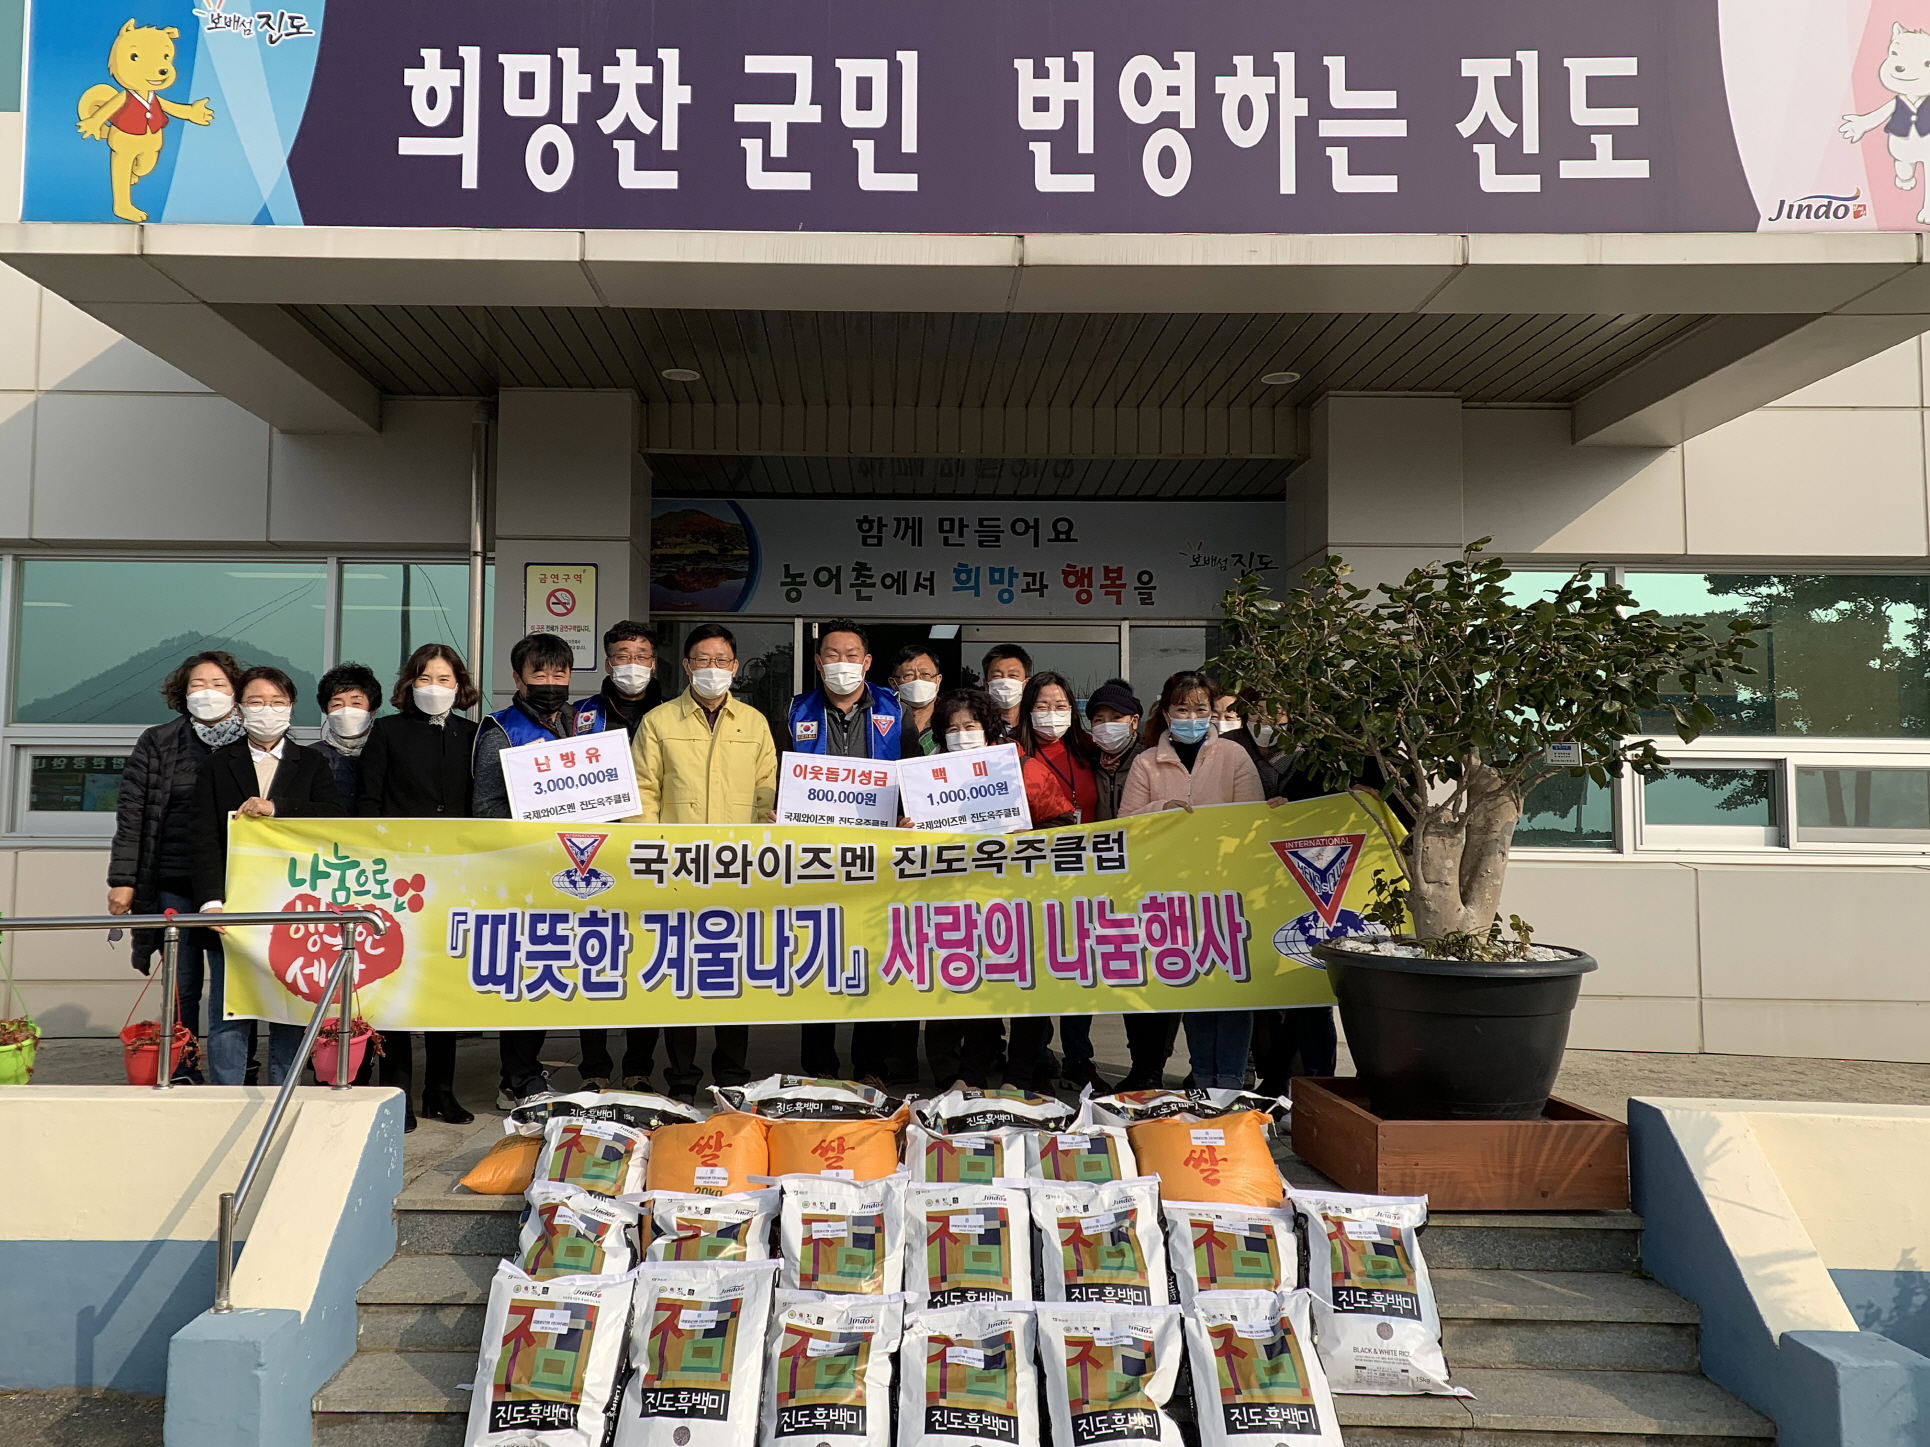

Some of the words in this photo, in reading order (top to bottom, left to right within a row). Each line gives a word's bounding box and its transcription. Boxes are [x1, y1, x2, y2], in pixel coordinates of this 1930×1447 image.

[206, 12, 253, 36] 보배섬
[256, 10, 314, 45] 진도
[398, 45, 692, 193] 희망찬
[734, 50, 919, 192] 군민
[1014, 51, 1408, 197] 번영하는
[1455, 50, 1650, 193] 진도
[1768, 199, 1851, 222] Jindo
[855, 514, 924, 548] 함께
[937, 516, 1079, 549] 만들어요
[1230, 551, 1280, 578] 진도
[538, 573, 583, 585] 금연구역
[779, 560, 936, 604] 농어촌에서
[952, 562, 1049, 605] 희망과
[1061, 562, 1158, 606] 행복을
[533, 767, 620, 796] 3,000,000원
[792, 763, 888, 788] 이웃돕기성금
[522, 802, 577, 821] 국제와이즈멘
[579, 792, 631, 812] 진도옥주클럽
[807, 788, 877, 807] 800,000원
[926, 780, 1010, 807] 1,000,000원
[784, 811, 835, 825] 국제와이즈멘
[916, 815, 968, 832] 국제와이즈멘
[970, 806, 1021, 825] 진도옥주클럽
[1285, 837, 1352, 849] INTERNATIONAL
[628, 841, 876, 886] 국제와이즈멘
[893, 830, 1128, 880] 진도옥주클럽
[287, 841, 392, 906] 나눔으로
[448, 907, 627, 998] 『따뜻한
[641, 905, 865, 996] 겨울나기』
[884, 896, 1029, 988] 사랑의
[1045, 890, 1245, 982] 나눔행사
[966, 1112, 1014, 1127] 진도흑백미
[688, 1130, 733, 1168] 쌀
[810, 1136, 856, 1170] 쌀
[1183, 1145, 1229, 1187] 쌀
[1337, 1289, 1418, 1316] 진도흑백미
[1353, 1346, 1373, 1355] BLACK
[1378, 1348, 1398, 1357] WHITE
[1416, 1376, 1431, 1384] 15kg
[495, 1403, 575, 1428] 진도흑백미
[645, 1390, 725, 1416] 진도흑백미
[780, 1407, 863, 1432] 진도흑백미
[930, 1410, 1015, 1439] 진도흑백미
[1077, 1411, 1159, 1439] 진도흑백미
[1230, 1405, 1316, 1431] 진도흑백미
